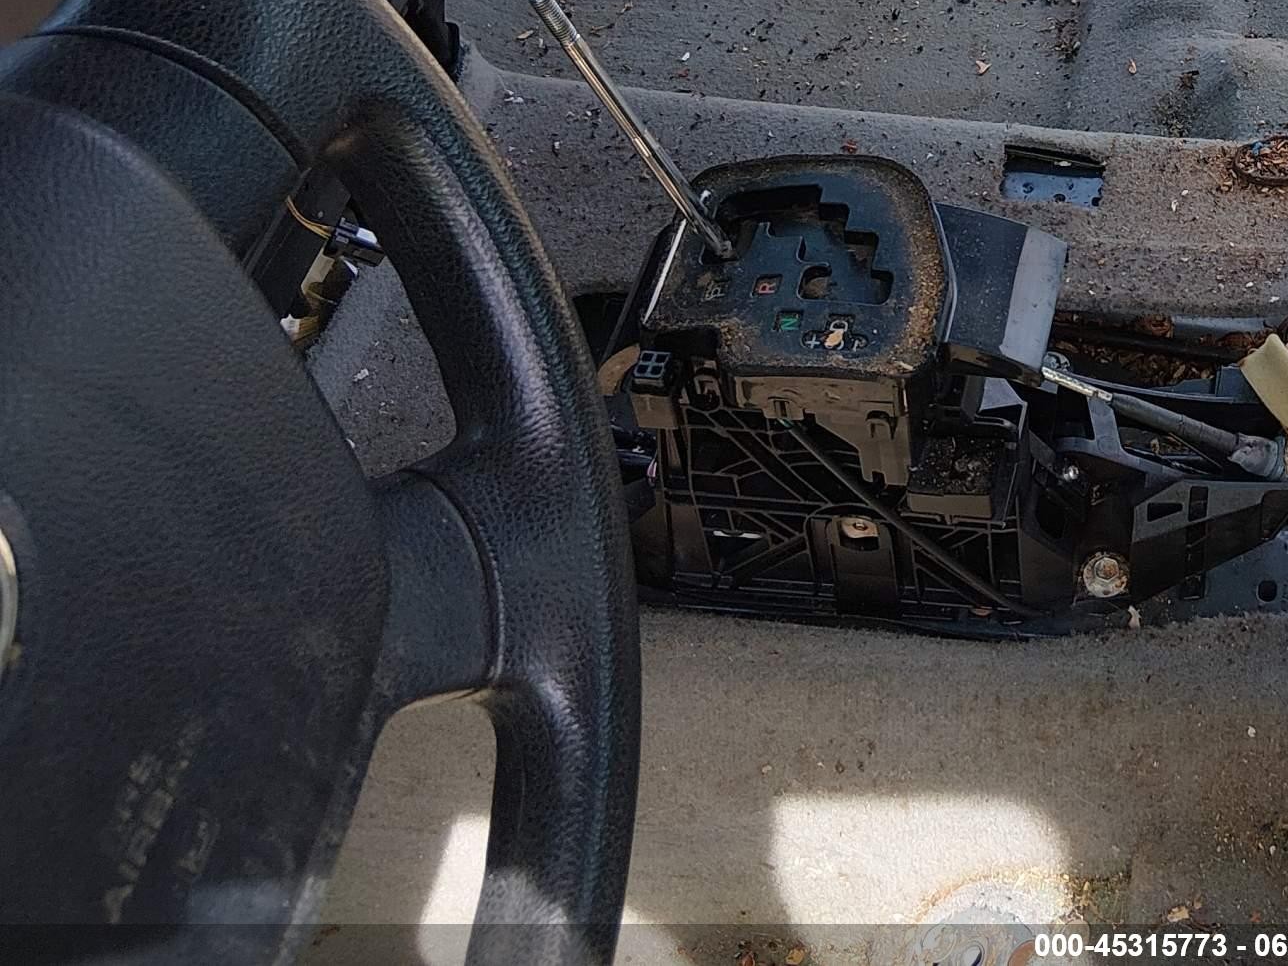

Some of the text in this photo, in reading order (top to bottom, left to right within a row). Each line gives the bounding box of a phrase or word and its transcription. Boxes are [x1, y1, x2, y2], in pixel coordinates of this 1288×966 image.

[758, 282, 776, 294] R
[780, 317, 799, 331] N
[829, 320, 848, 332] D
